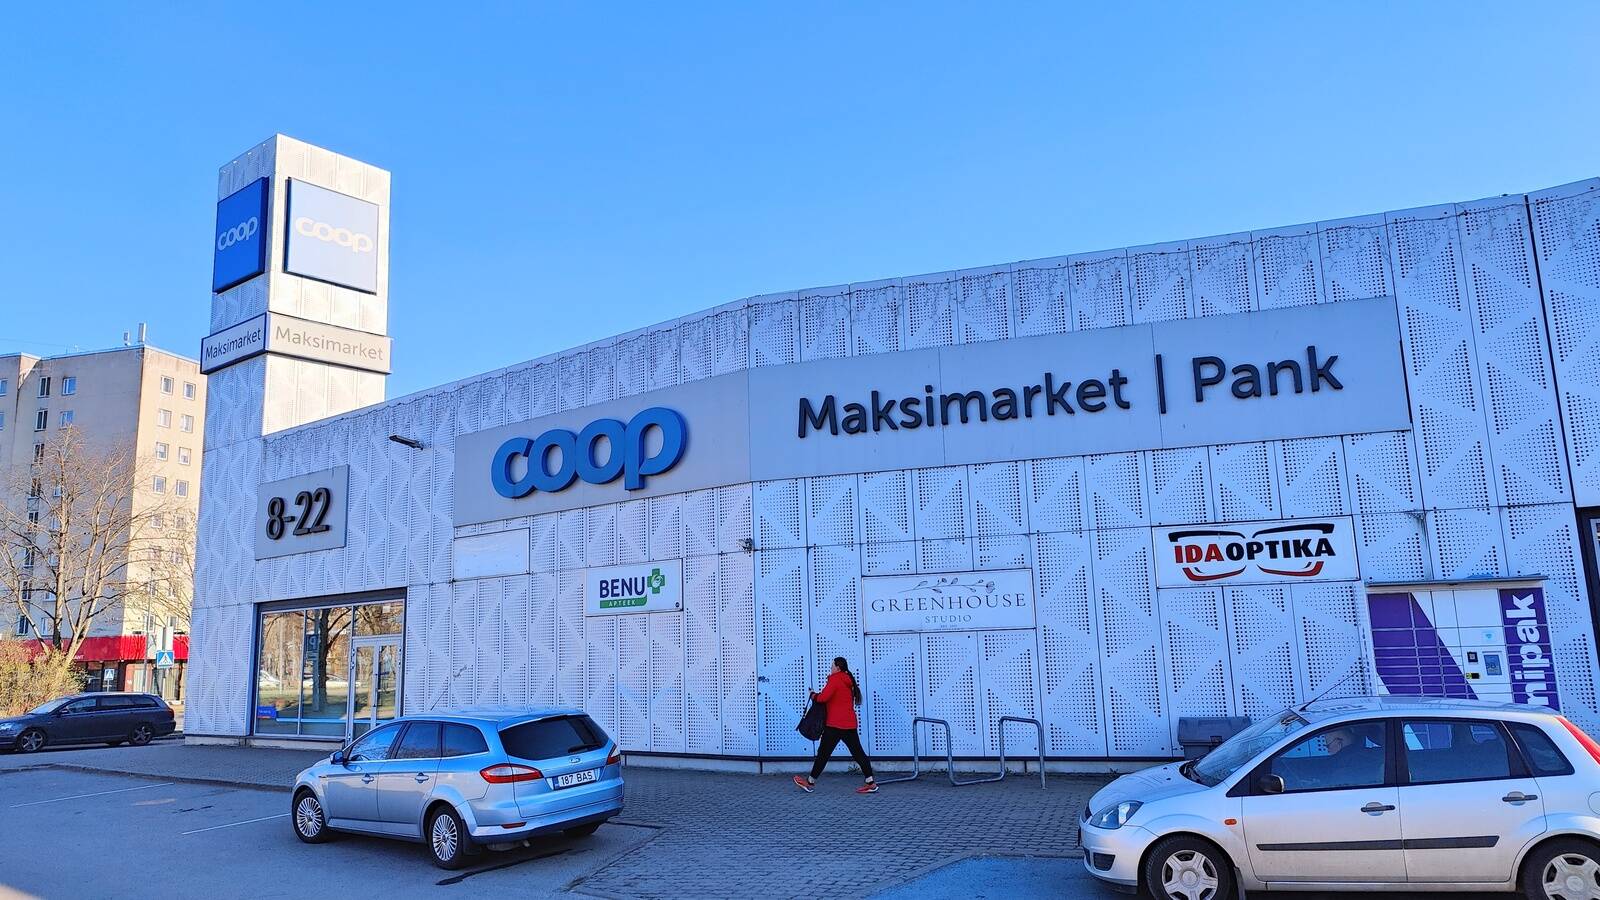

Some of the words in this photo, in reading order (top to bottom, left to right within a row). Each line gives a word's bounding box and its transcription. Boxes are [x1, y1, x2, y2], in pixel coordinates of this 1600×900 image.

[217, 216, 259, 251] coop
[295, 216, 374, 253] coop
[205, 327, 262, 361] Maksimarket
[275, 325, 384, 361] Maksimarket
[797, 369, 1132, 439] Maksimarket
[1191, 345, 1344, 403] Pank
[491, 407, 688, 499] coop
[266, 487, 331, 540] 8-22
[600, 576, 645, 598] BENU
[871, 593, 1026, 613] GREENHOUSE
[925, 614, 972, 624] STUDIO
[1505, 593, 1550, 706] nipak
[561, 774, 574, 785] 187
[577, 771, 593, 782] BAS
